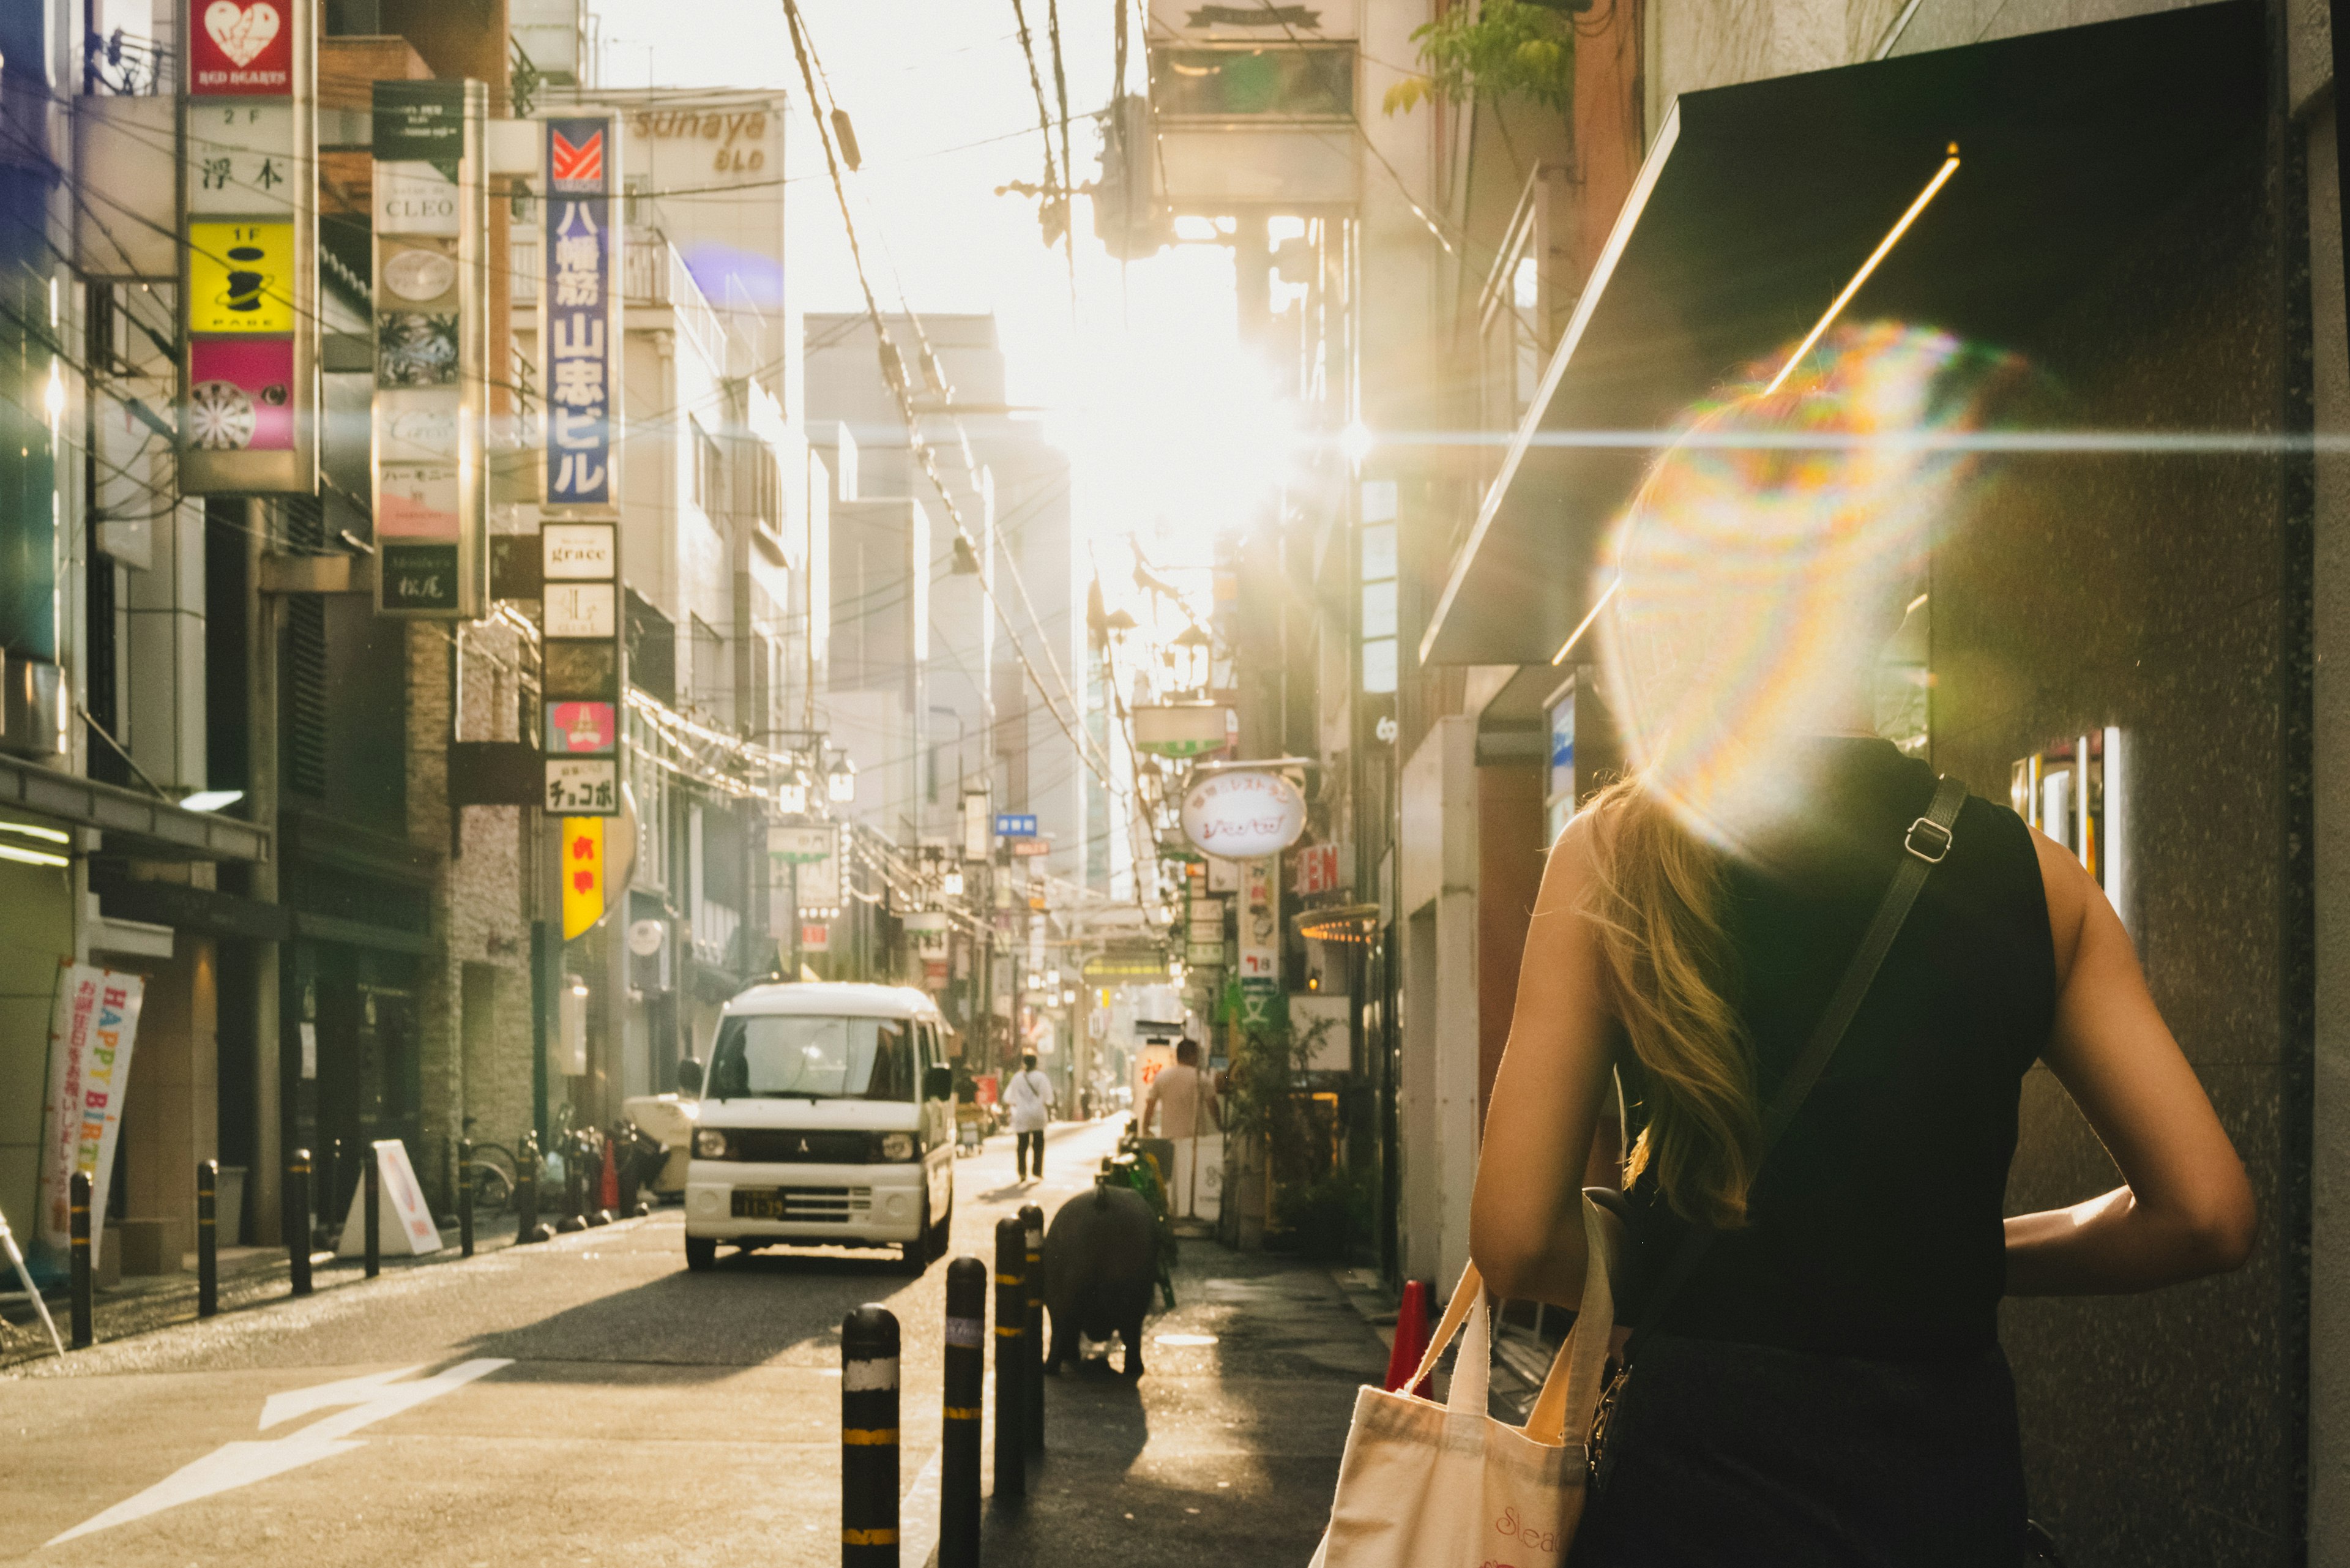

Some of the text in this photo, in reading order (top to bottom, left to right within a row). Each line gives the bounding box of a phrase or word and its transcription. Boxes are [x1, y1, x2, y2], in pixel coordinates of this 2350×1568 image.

[199, 71, 286, 85] RED HEARTS
[386, 200, 453, 217] CLEO
[552, 547, 606, 563] grace
[89, 986, 127, 1087] HAPPY
